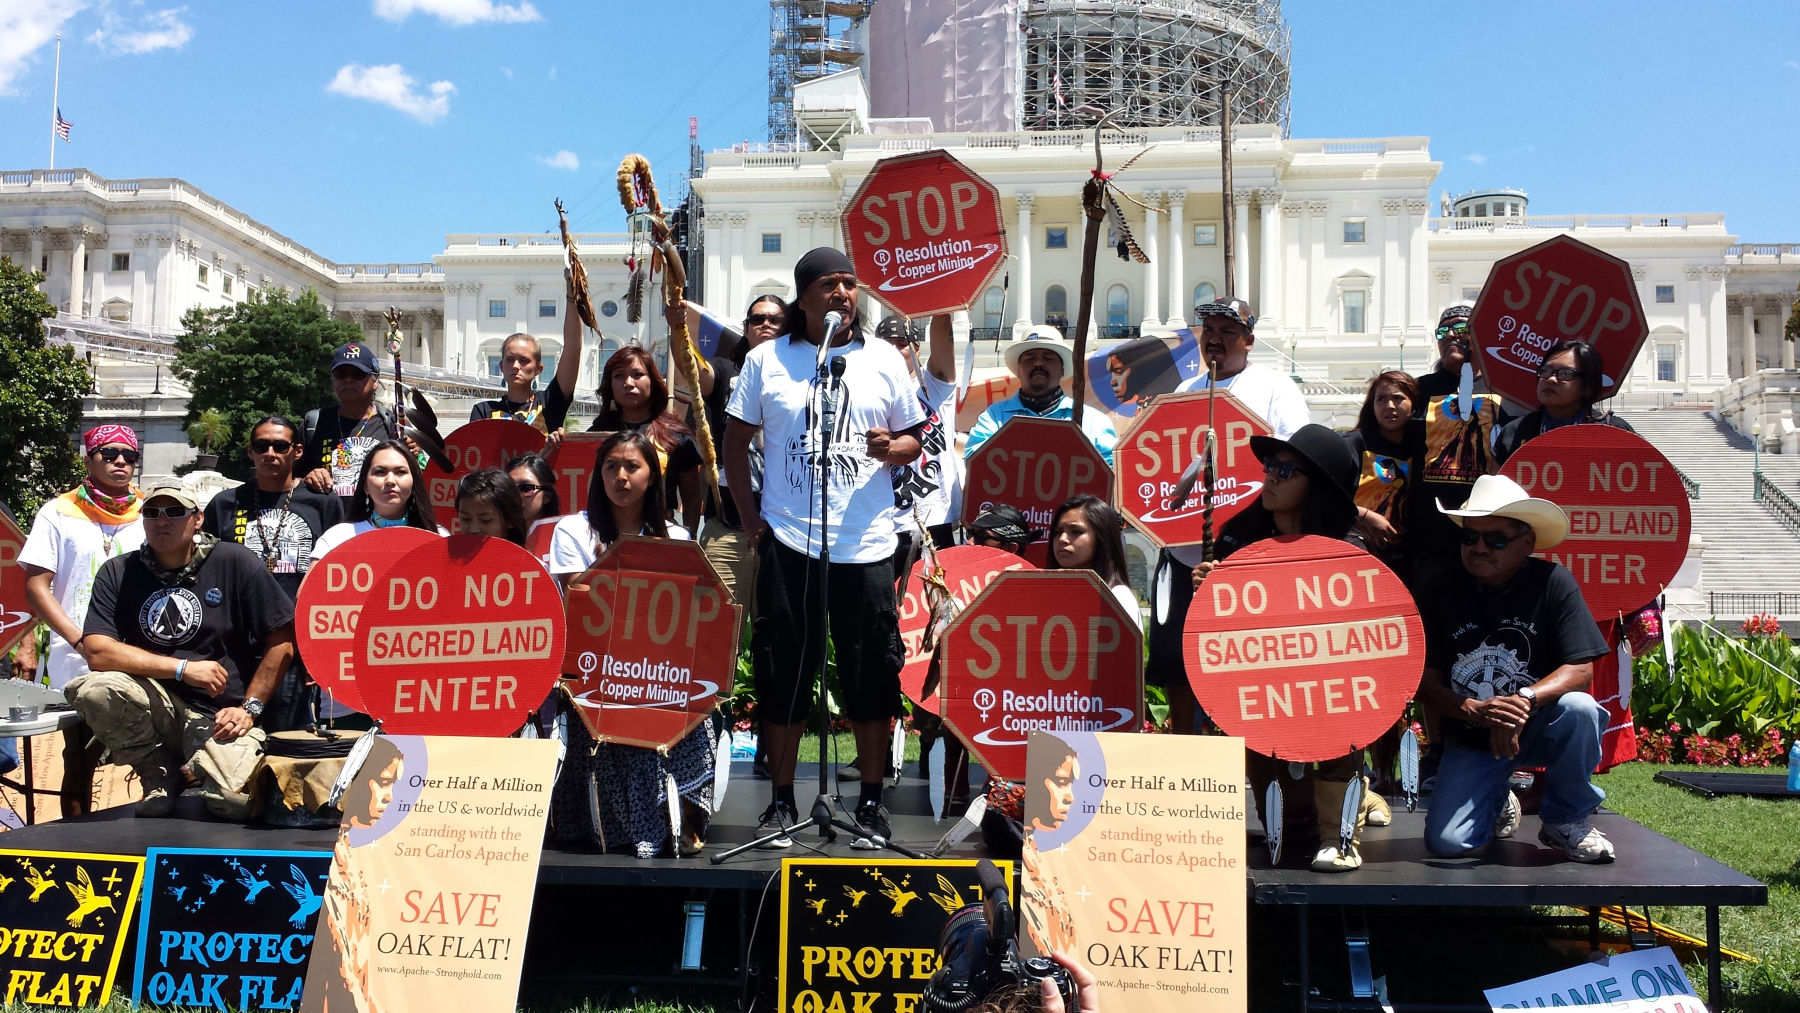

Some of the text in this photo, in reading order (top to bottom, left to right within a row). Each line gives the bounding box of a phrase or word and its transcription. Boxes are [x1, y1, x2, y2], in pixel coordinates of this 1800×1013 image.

[862, 181, 979, 246] STOP
[894, 238, 972, 264] Resolution
[898, 255, 974, 280] Copper Mining
[1503, 261, 1632, 345] STOP
[1511, 342, 1544, 366] Coppe
[1135, 420, 1254, 477] STOP
[983, 447, 1095, 501] STOP
[1515, 461, 1664, 492] DO NOT
[1609, 511, 1674, 535] LAND
[326, 563, 374, 592] DO
[388, 571, 540, 611] DO NOT
[1212, 568, 1380, 617] DO NOT
[314, 610, 360, 635] SAC
[582, 573, 720, 648] STOP
[372, 626, 548, 659] SACRED LAND
[966, 614, 1121, 681] STOP
[1204, 622, 1403, 666] SACRED LAND
[602, 654, 690, 684] Resolution
[394, 675, 517, 713] ENTER
[600, 679, 689, 707] Copper Mining
[1002, 689, 1103, 713] Resolution
[1238, 675, 1380, 721] ENTER
[1002, 714, 1103, 735] Copper Mining
[409, 775, 543, 792] Over Half a Million
[1088, 774, 1238, 793] Over Half a Million
[398, 800, 544, 817] in the US & worldwide
[1082, 801, 1244, 821] in the US & worldwide
[410, 824, 522, 842] standing with the
[1100, 825, 1224, 847] standing with the
[394, 842, 529, 866] San Carlos Apache
[1088, 846, 1237, 872] San Carlos Apache
[400, 889, 501, 927] SAVE
[1107, 898, 1215, 938] SAVE
[159, 930, 314, 968] PROTEC
[377, 932, 511, 961] OAK FLAT!
[1087, 943, 1233, 974] OAK FLAT!
[801, 946, 943, 985] PROTE
[7, 970, 101, 1007] FLAT
[148, 971, 304, 1013] OAK FLA
[1632, 964, 1689, 1002] ON
[792, 989, 881, 1013] OAK
